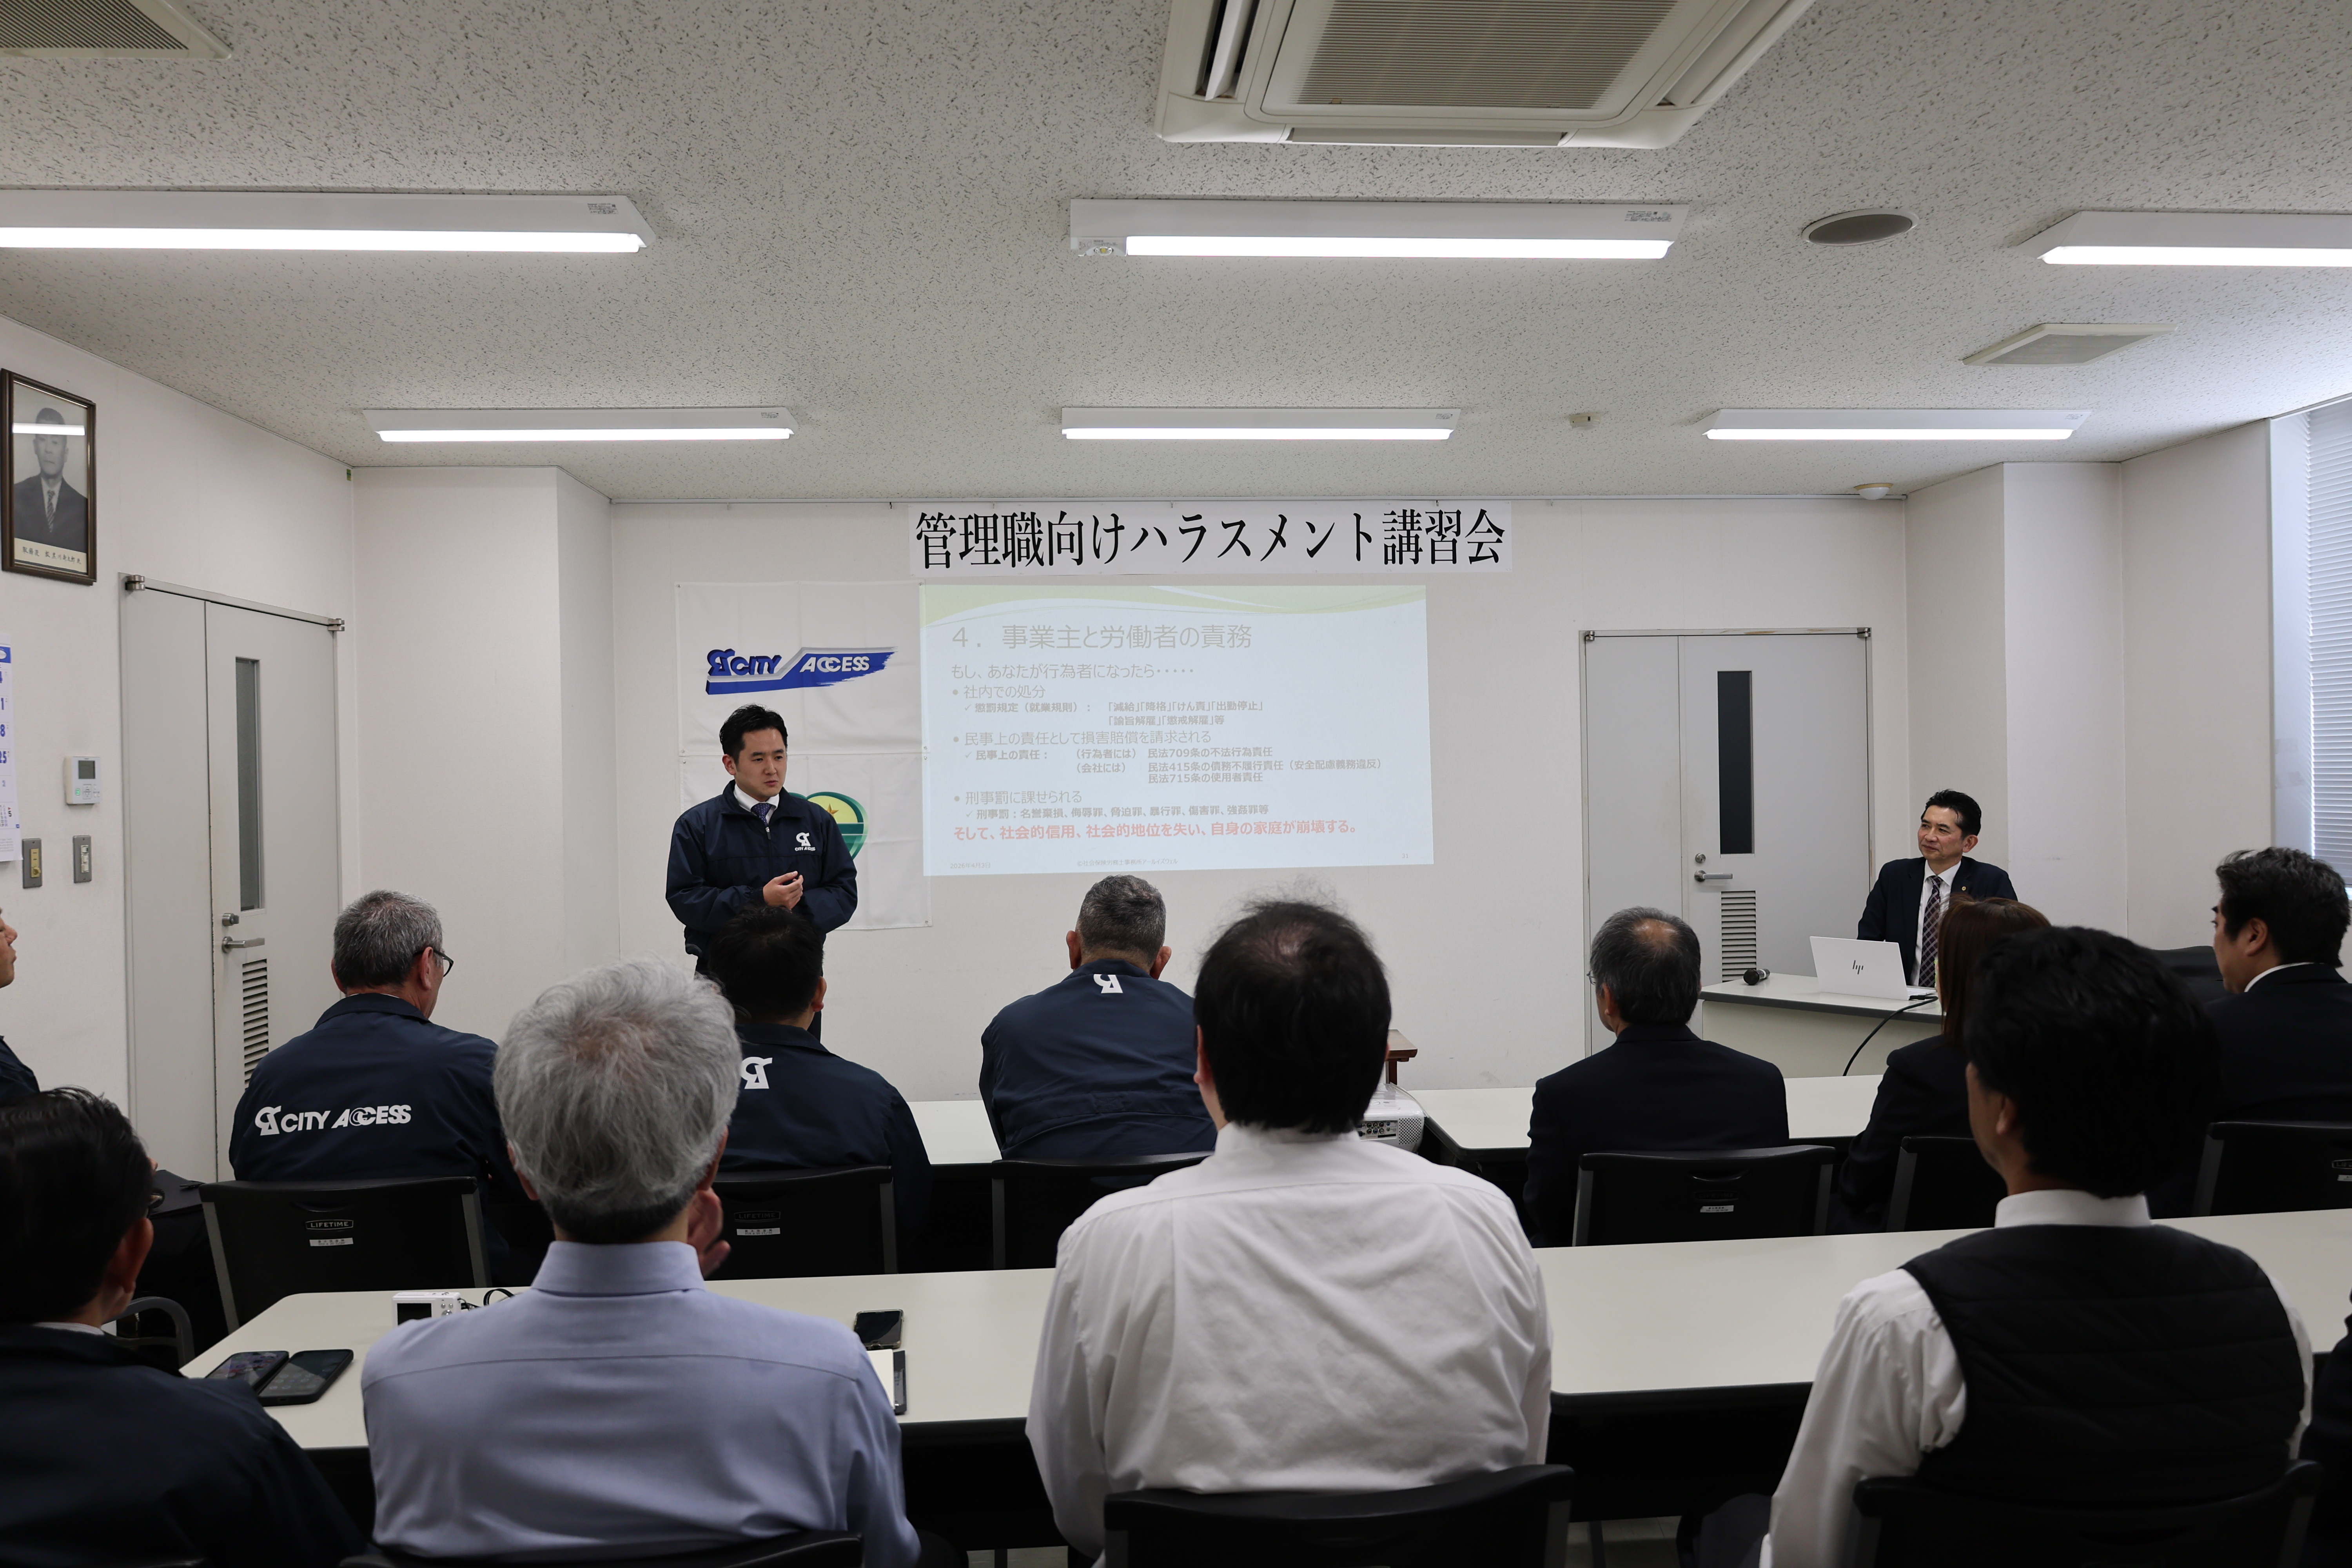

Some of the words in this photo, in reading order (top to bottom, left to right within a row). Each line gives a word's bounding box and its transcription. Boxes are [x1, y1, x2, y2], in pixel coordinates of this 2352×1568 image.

[915, 507, 1506, 570] 管理職向けハラスメント講習会
[1002, 624, 1252, 650] 事業主と労働者の責務
[730, 654, 782, 675] CITY
[799, 656, 871, 673] ACCESS
[963, 684, 1046, 699] 社内での処分
[965, 730, 1211, 745] 民事上の責任として損害賠償を請求される
[1148, 747, 1272, 759] 民法709条の不法行為責任
[1149, 772, 1263, 784] 民法715条の使用者責任
[965, 790, 1082, 805] 刑事罰に課せられる
[954, 820, 1356, 840] そして、社会的信用、社会的地位を失い、自身の家庭が崩壊する。
[281, 1110, 331, 1133] CITY
[331, 1105, 412, 1129] ACCESS
